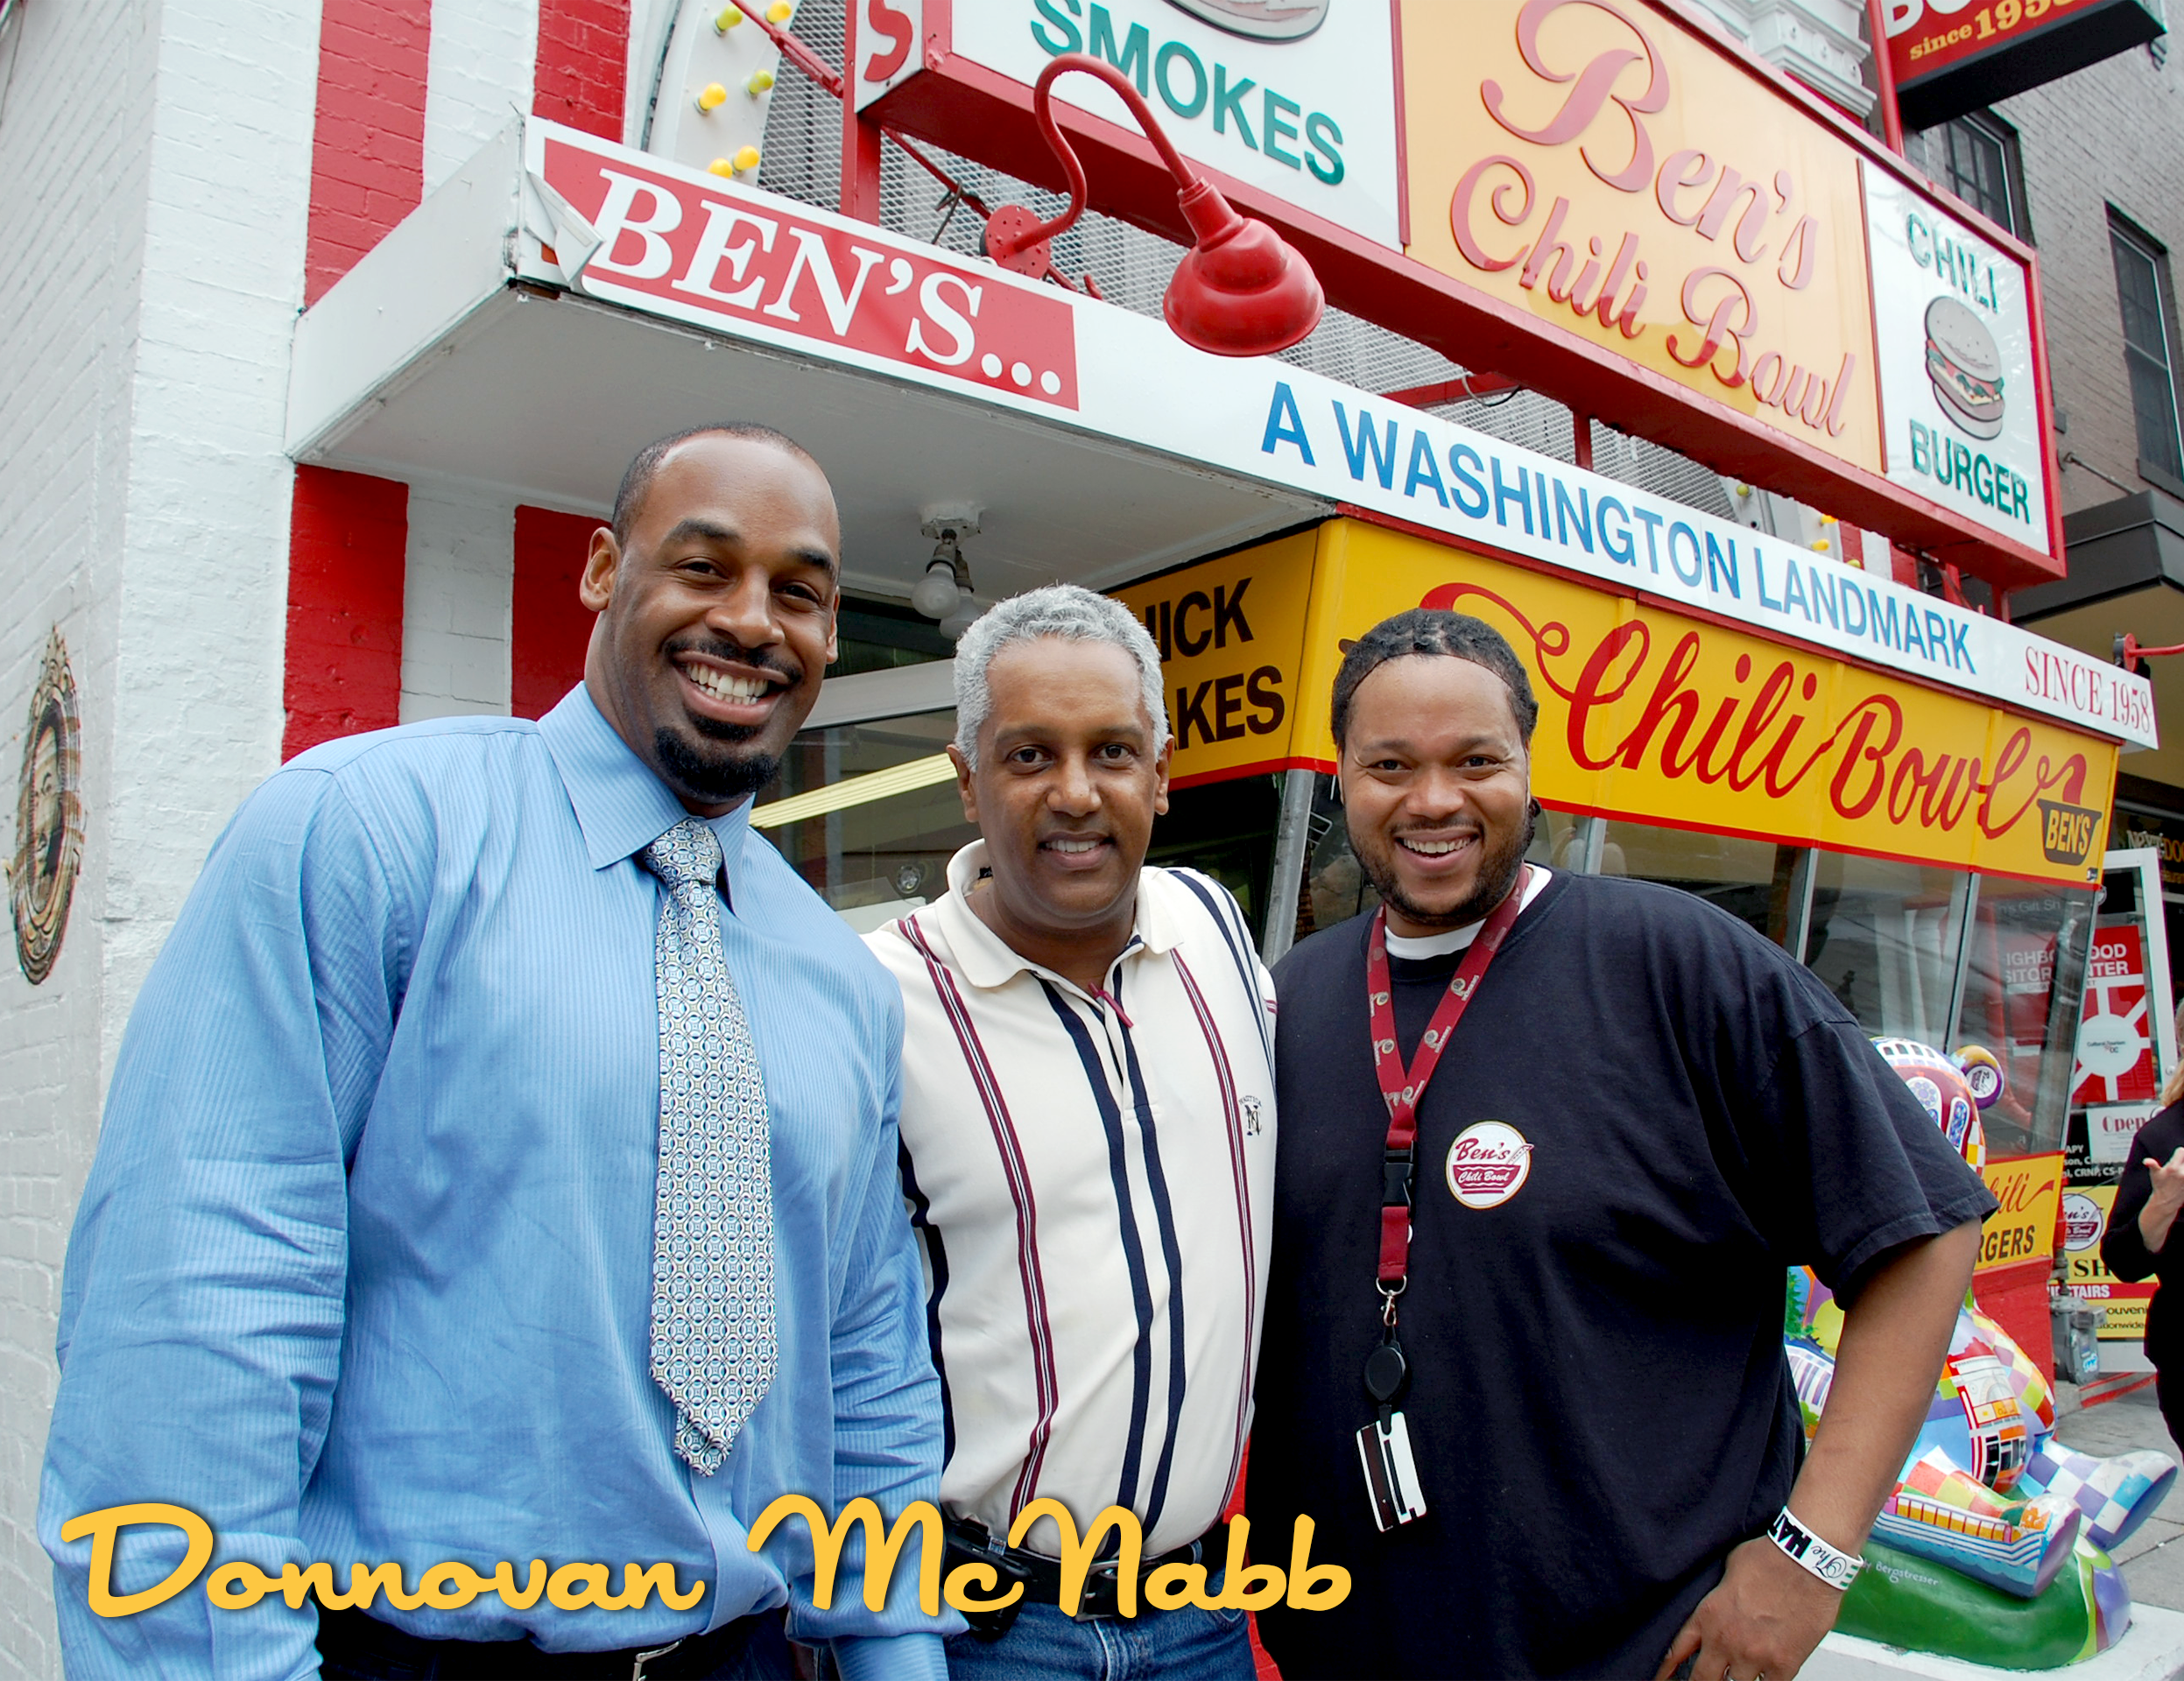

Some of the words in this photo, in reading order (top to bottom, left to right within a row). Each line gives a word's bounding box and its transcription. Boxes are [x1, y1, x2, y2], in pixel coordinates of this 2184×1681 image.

[1909, 24, 1973, 60] since
[1030, 0, 1346, 186] SMOKES
[1480, 0, 1820, 290] Ben's
[1449, 154, 1648, 340] Chili
[1666, 265, 1856, 438] Bowl
[1906, 213, 1998, 314] CHILI
[1909, 418, 2031, 525] BURGER
[1260, 381, 1316, 468] A
[1330, 398, 1741, 601] WASHINGTON
[1752, 546, 1977, 676] LANDMARK
[2024, 645, 2103, 717] SINCE
[2110, 679, 2152, 735] 1958
[1145, 576, 1255, 664] ICK
[1168, 665, 1286, 752] KES
[1489, 595, 1828, 798] Chili
[1828, 692, 2045, 840] Bowl
[2046, 807, 2093, 855] BEN'S
[1455, 1137, 1511, 1162] Ben's
[1458, 1171, 1483, 1184] Chili
[1483, 1170, 1511, 1181] Bowl
[1977, 1224, 2036, 1263] RGERS
[2073, 1258, 2110, 1277] SH
[1810, 1545, 1847, 1579] The
